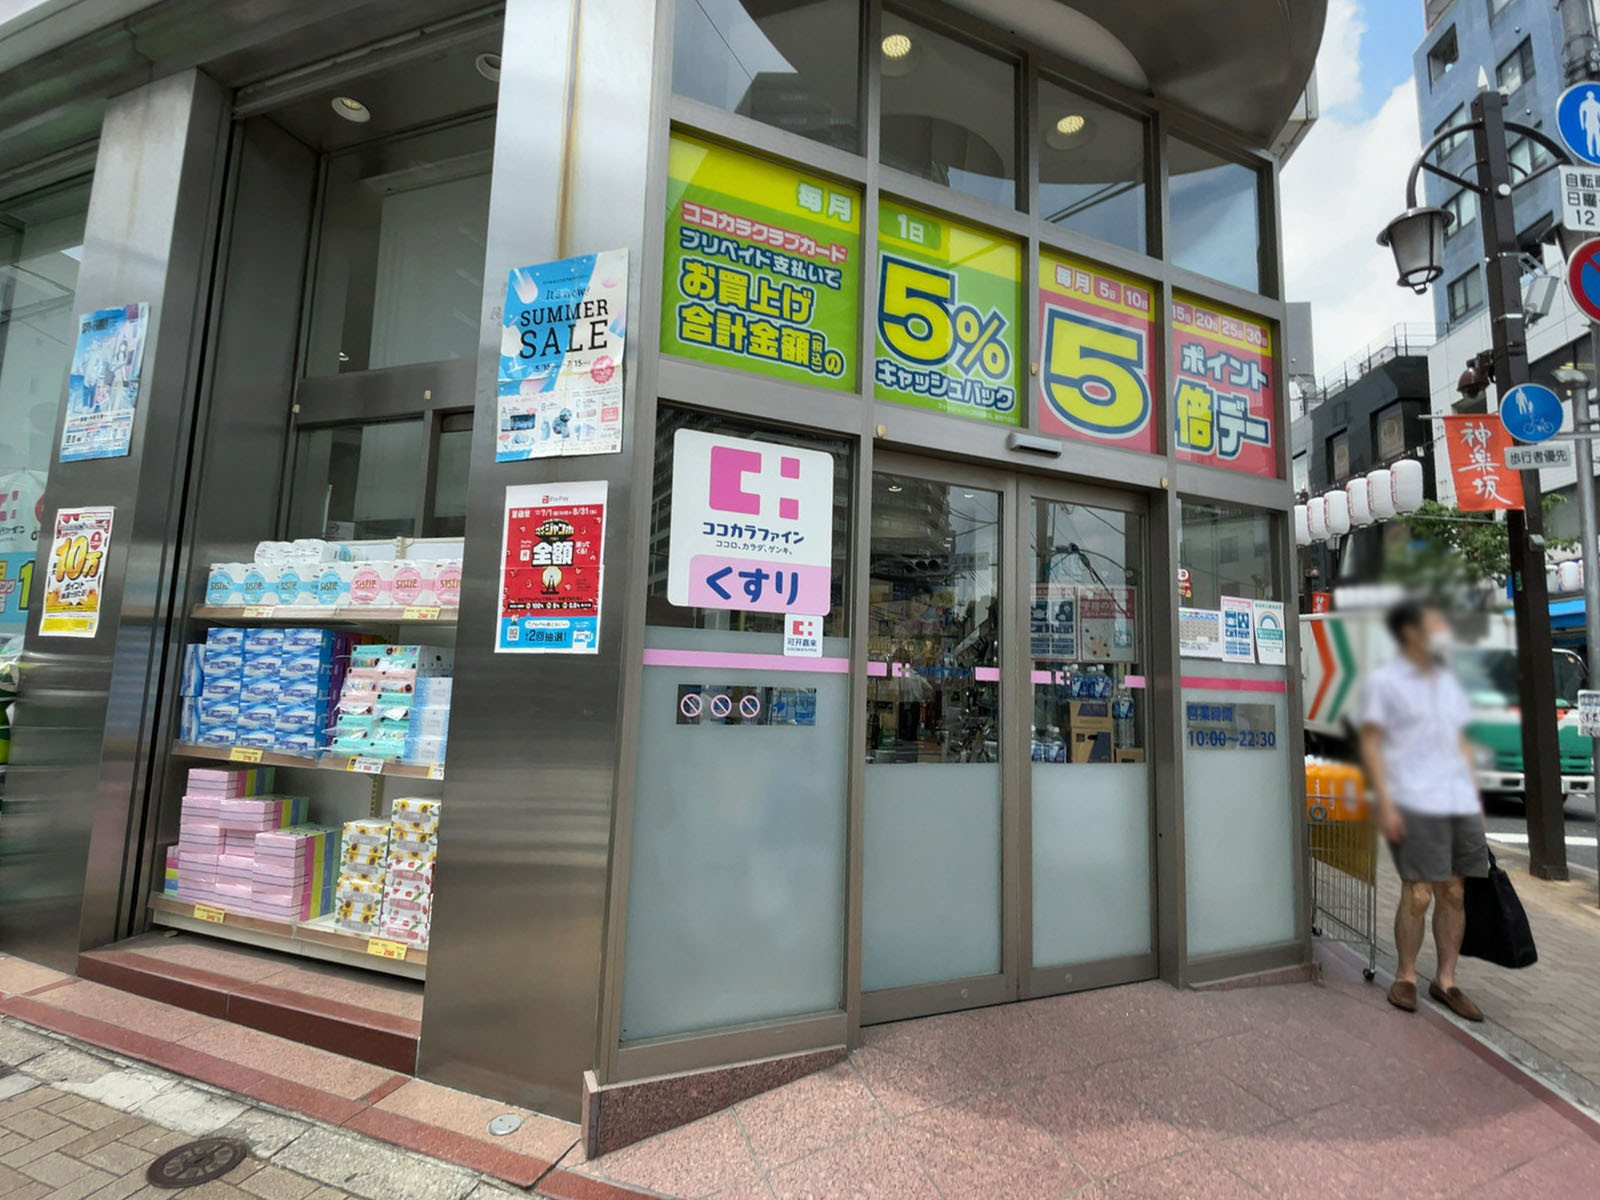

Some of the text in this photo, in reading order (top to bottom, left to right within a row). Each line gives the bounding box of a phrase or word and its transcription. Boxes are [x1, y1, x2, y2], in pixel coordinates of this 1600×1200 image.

[797, 182, 851, 222] 毎月
[1576, 209, 1596, 226] 12
[681, 201, 848, 264] ココカラクラブカード
[897, 214, 924, 244] 1日
[680, 257, 815, 325] お買上げ
[1056, 264, 1091, 294] 毎月
[520, 298, 608, 328] SUMMER
[878, 251, 1013, 382] 5%
[519, 319, 608, 360] SALE
[874, 357, 1015, 413] キャッシュバック
[1040, 303, 1152, 440] 5
[1181, 342, 1269, 393] ポイント
[1174, 375, 1271, 460] 倍デー
[1458, 421, 1514, 506] 神楽坂
[702, 521, 805, 545] ココカラファイン
[56, 535, 103, 583] 10万
[706, 566, 799, 606] くすり
